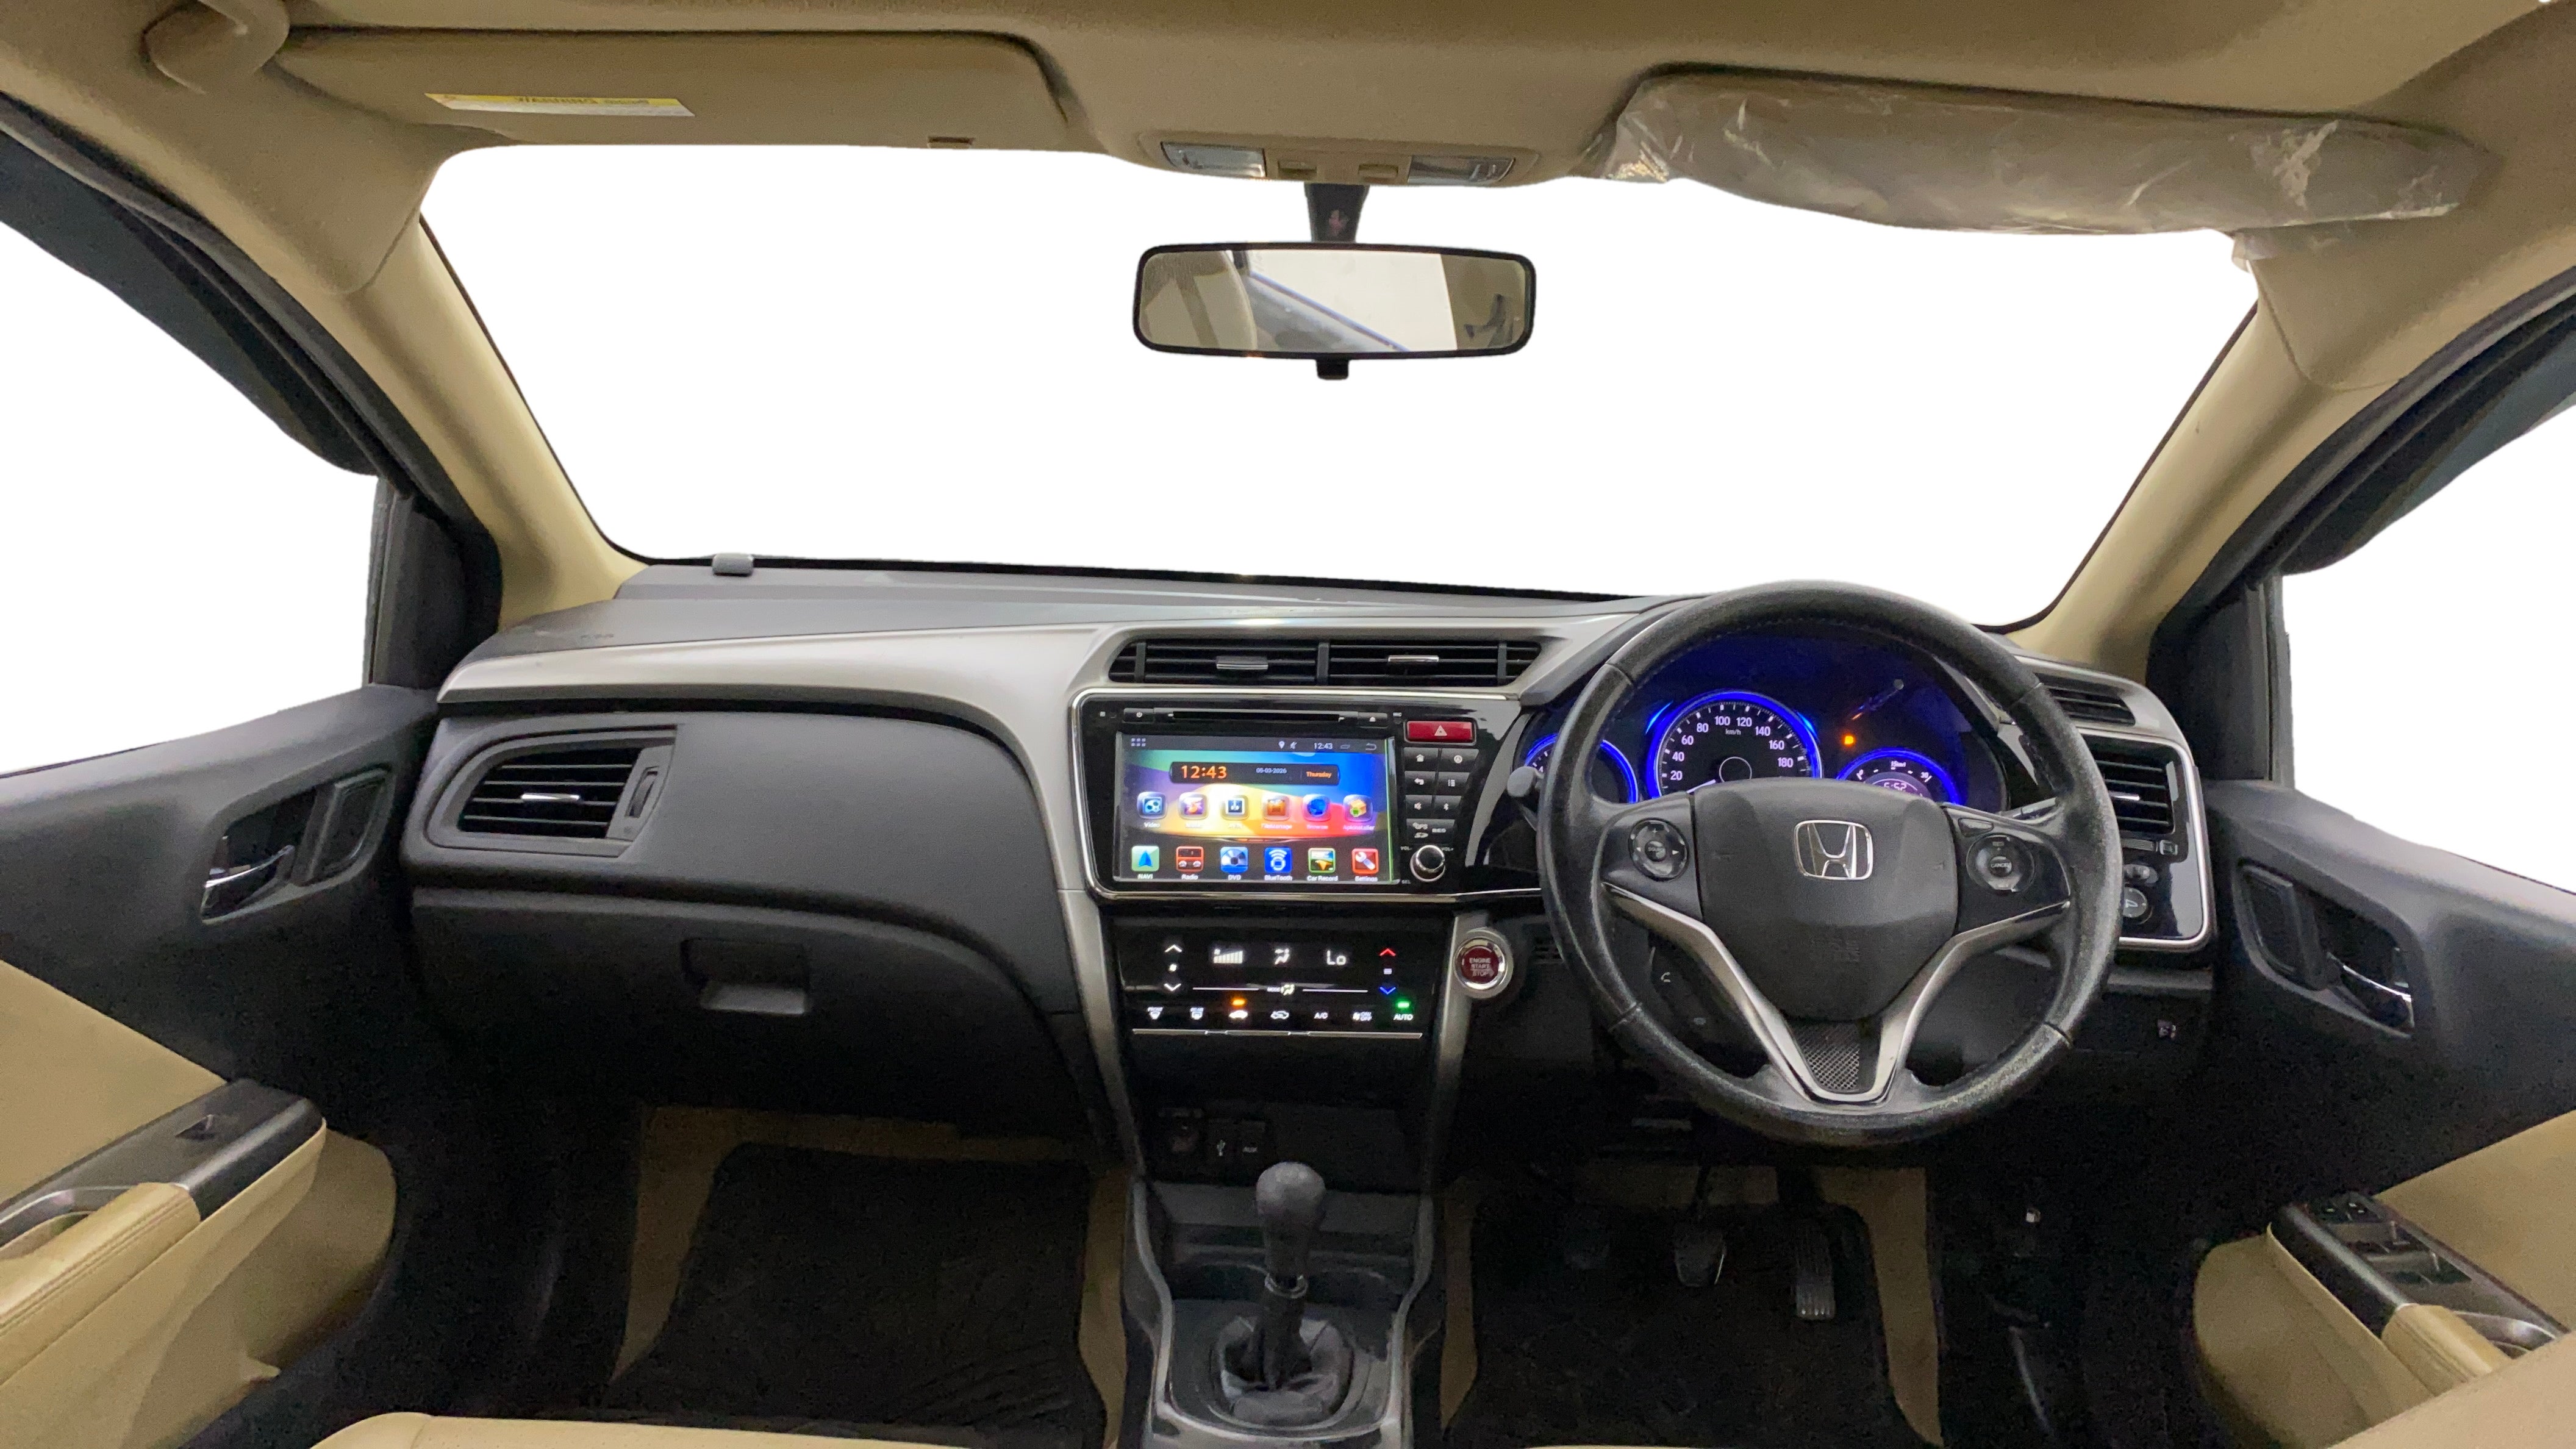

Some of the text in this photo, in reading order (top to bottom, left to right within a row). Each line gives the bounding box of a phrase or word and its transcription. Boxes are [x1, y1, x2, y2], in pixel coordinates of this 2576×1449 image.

[1715, 716, 1731, 725] 100
[1736, 717, 1752, 727] 120
[1697, 723, 1709, 732] 80
[1755, 726, 1771, 736] 140
[1681, 735, 1694, 745] 60
[1769, 740, 1785, 750] 160
[1672, 751, 1685, 762] 40
[1778, 757, 1794, 768] 180
[1181, 765, 1228, 779] 12:43
[1670, 770, 1683, 781] 20
[1326, 950, 1347, 965] Lo
